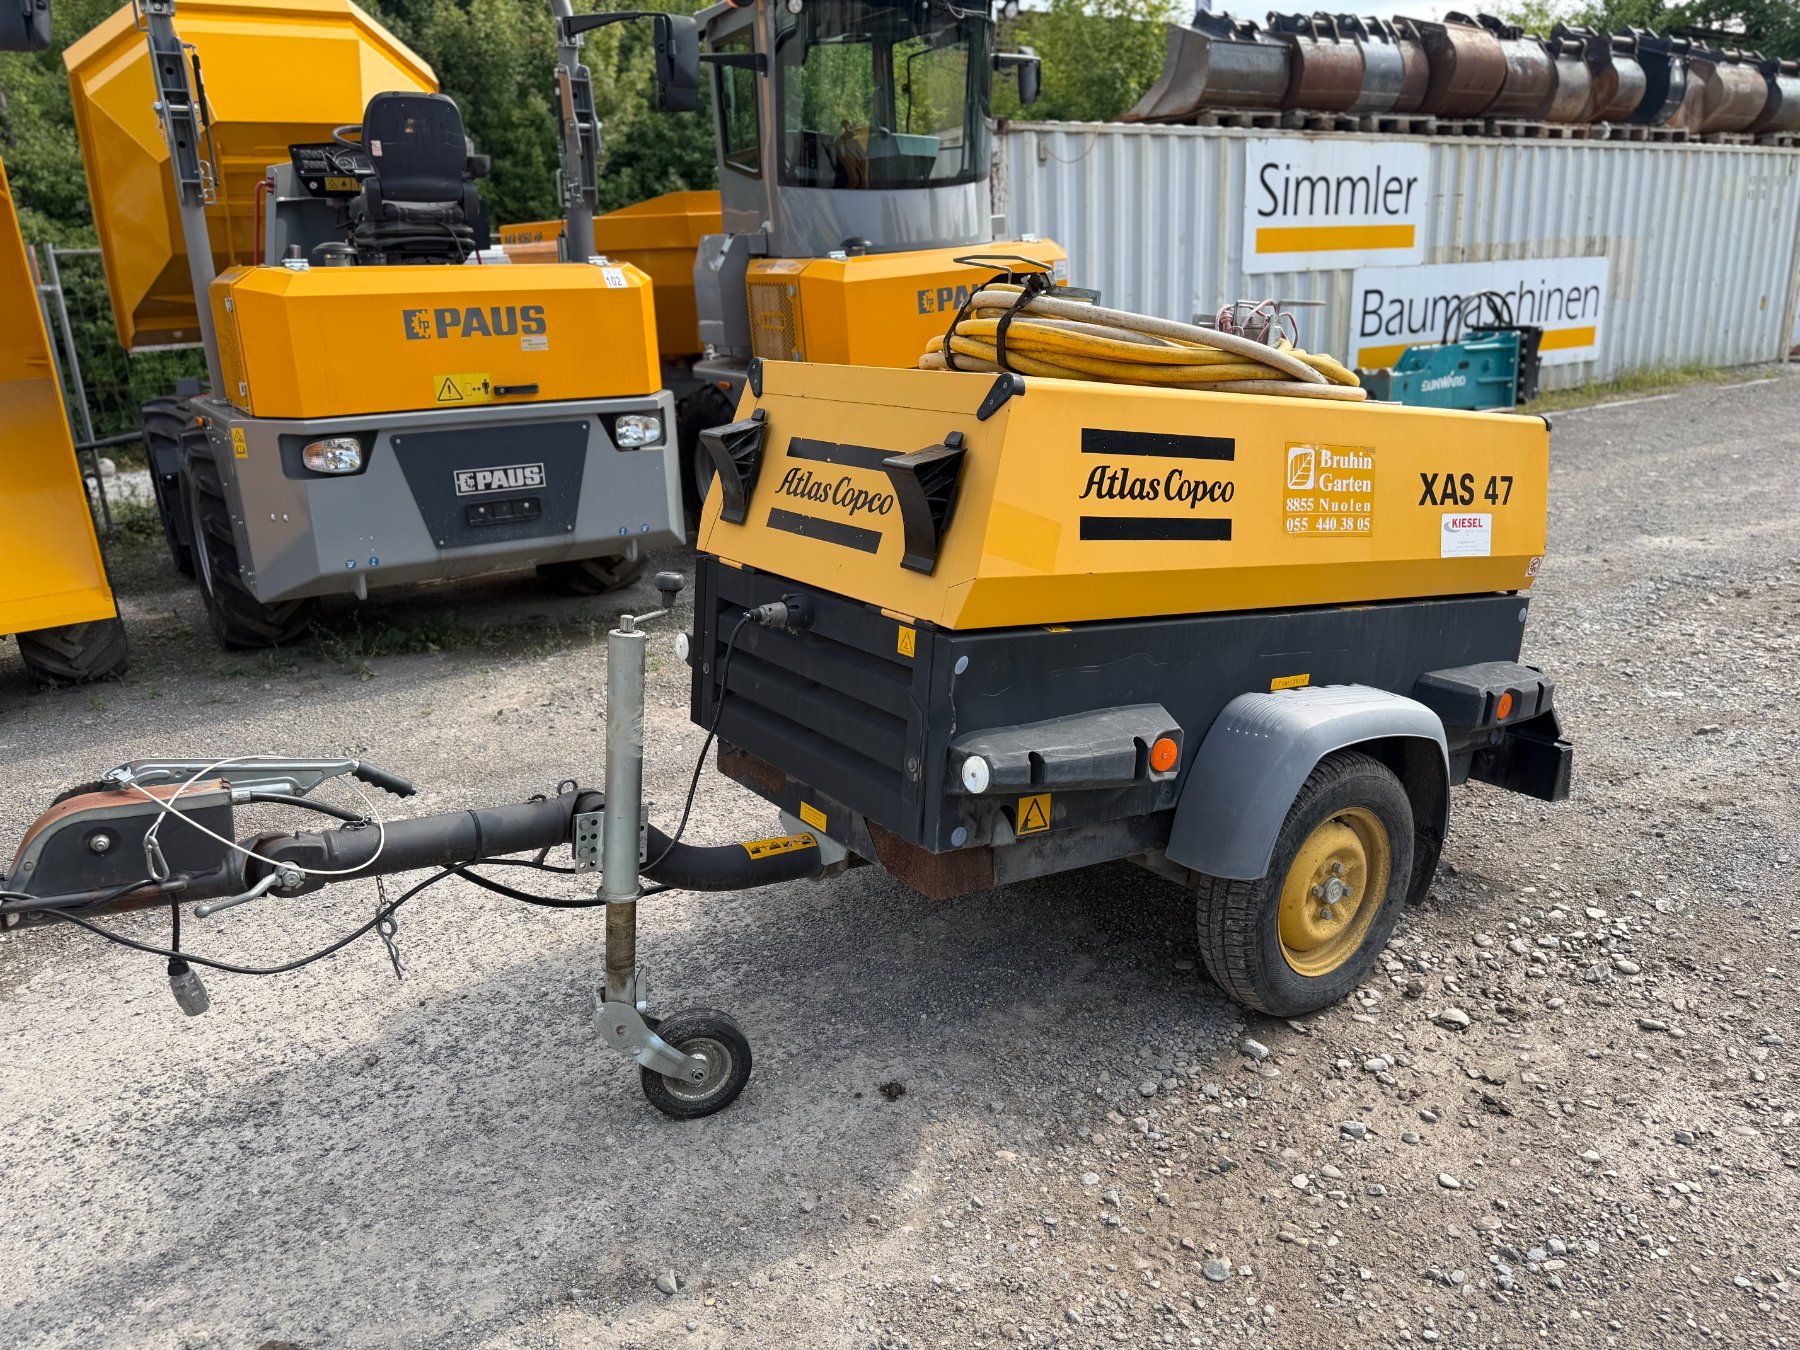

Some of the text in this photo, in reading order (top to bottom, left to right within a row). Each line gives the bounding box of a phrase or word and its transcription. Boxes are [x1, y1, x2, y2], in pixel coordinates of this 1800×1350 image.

[1257, 162, 1418, 217] Simmler
[606, 275, 623, 287] 102
[937, 283, 988, 312] PA
[433, 305, 547, 339] PAUS
[1319, 448, 1373, 469] Bruhin
[775, 467, 894, 516] Atlas Copco
[1079, 465, 1235, 509] Atlas Copco
[1319, 473, 1372, 492] Garten
[1418, 472, 1514, 506] XAS 47
[1286, 497, 1371, 512] 8855 Nuolen
[1286, 517, 1370, 531] 055 440 38 05
[1451, 517, 1483, 528] KIESEL
